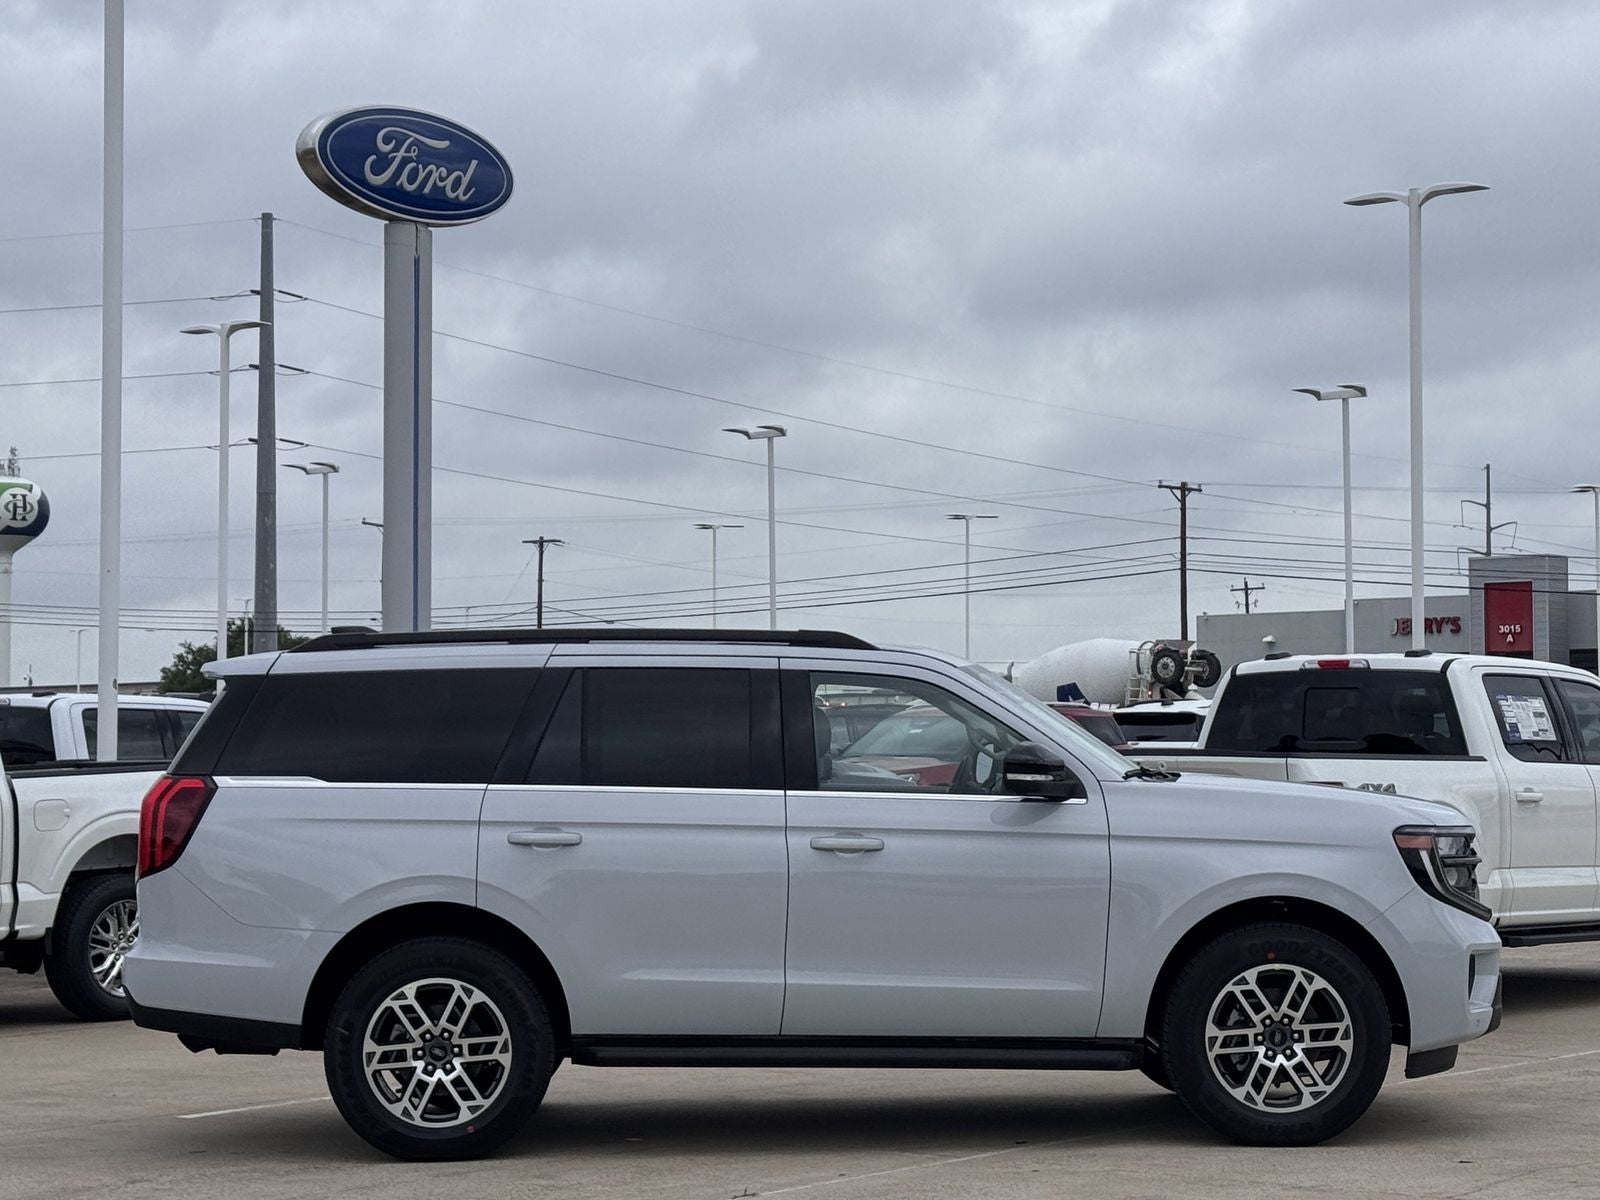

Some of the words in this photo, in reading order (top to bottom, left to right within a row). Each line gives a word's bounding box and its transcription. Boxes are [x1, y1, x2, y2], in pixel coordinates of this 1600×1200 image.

[364, 127, 478, 201] Ford
[1392, 616, 1462, 635] JERY'S
[1498, 624, 1521, 634] 3015
[1506, 633, 1514, 643] A
